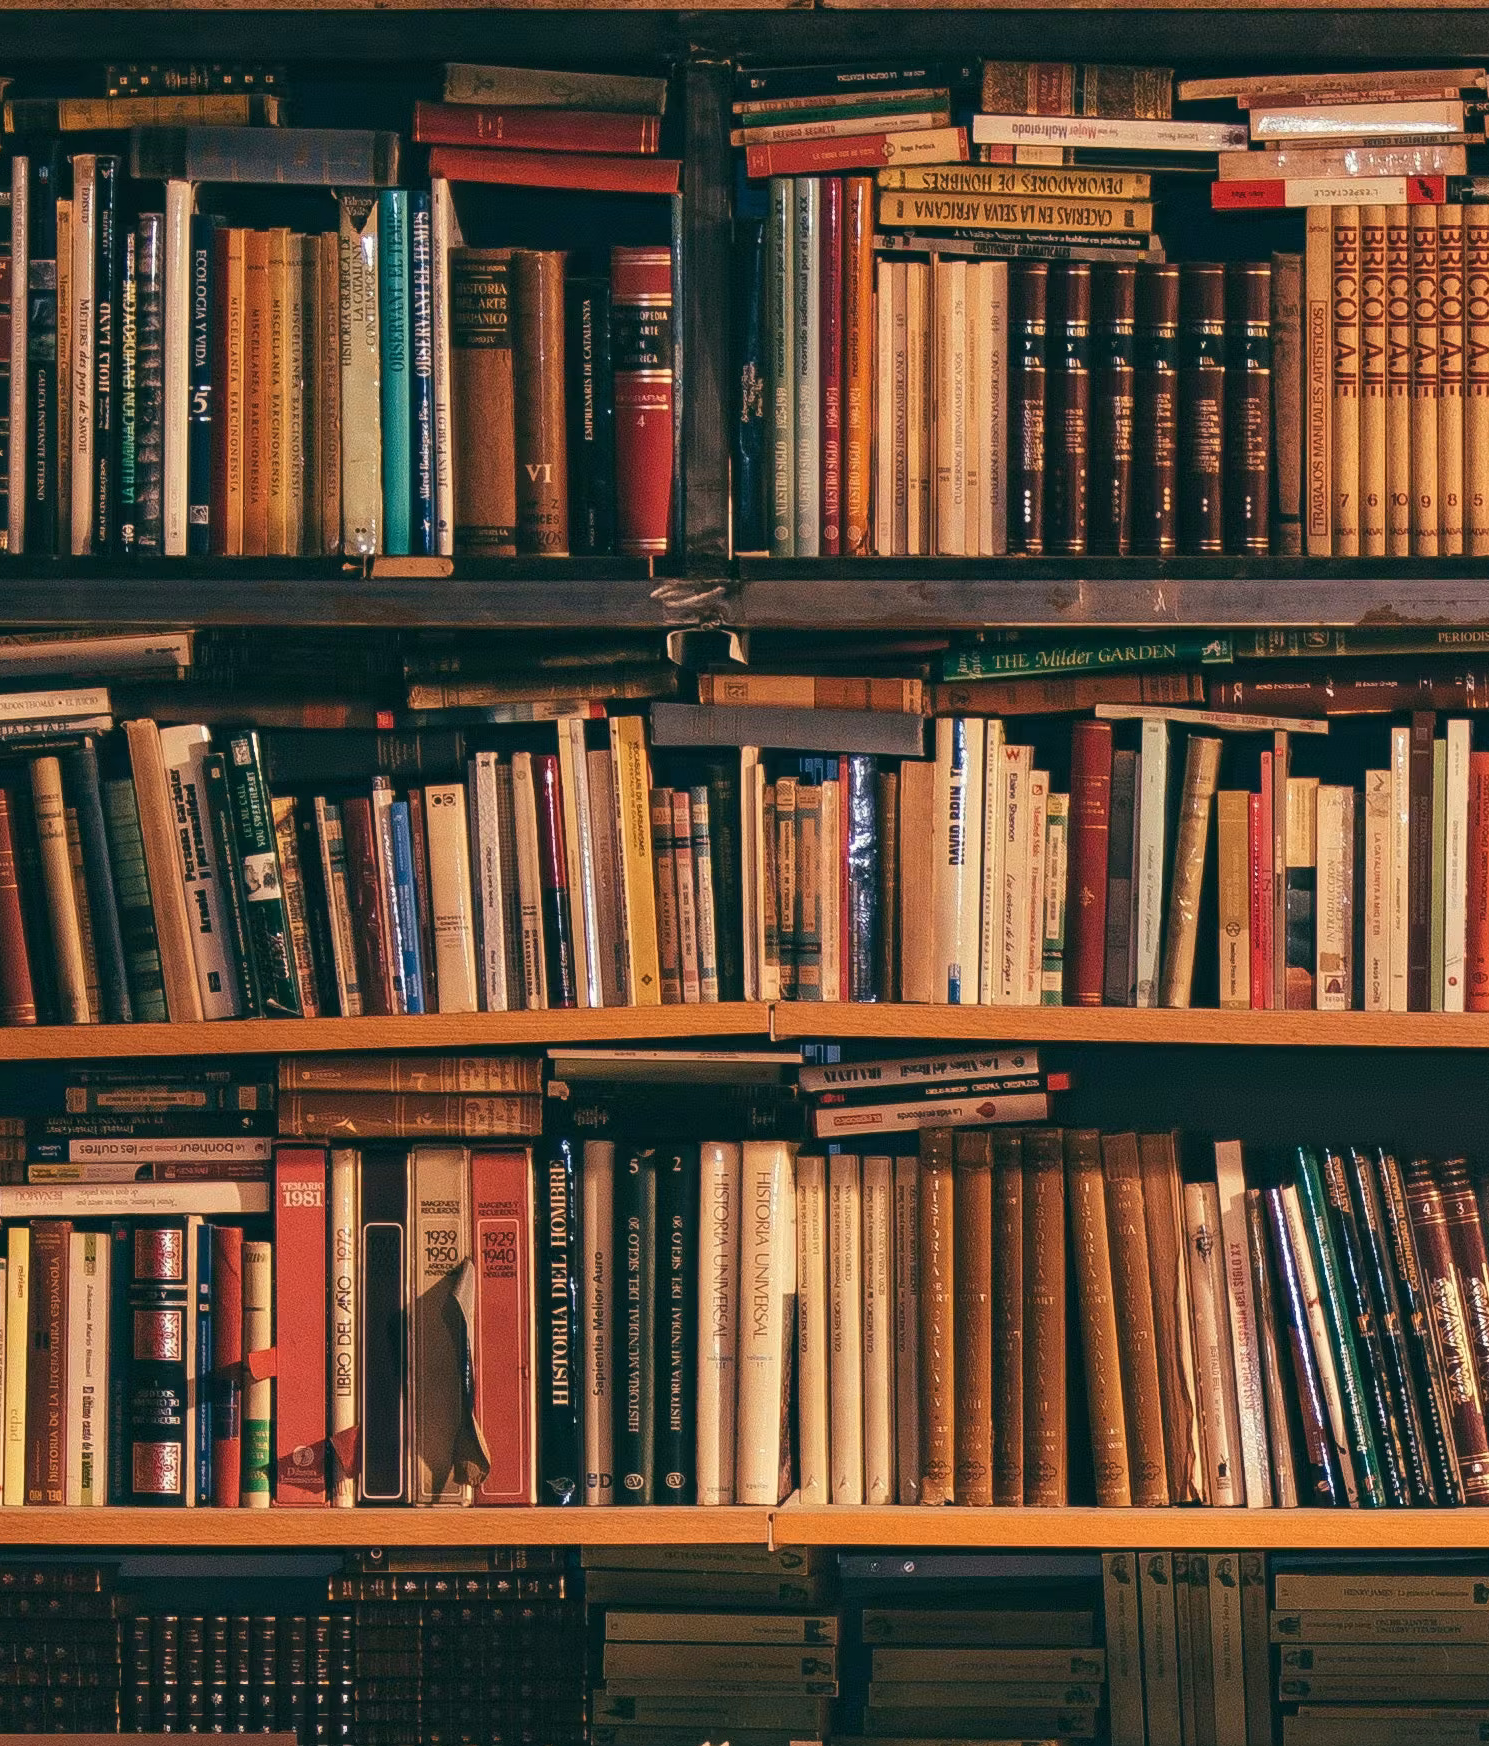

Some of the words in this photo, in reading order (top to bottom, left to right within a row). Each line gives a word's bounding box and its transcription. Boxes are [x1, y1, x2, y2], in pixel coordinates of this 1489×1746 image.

[922, 173, 991, 191] HOMBRES
[998, 174, 1015, 192] DE
[1022, 174, 1123, 195] DEVORADORES
[915, 200, 980, 223] AFRICANA
[983, 203, 1017, 224] SELVA
[1020, 205, 1035, 224] LA
[1038, 206, 1053, 225] EN
[99, 302, 111, 345] LAND
[1334, 225, 1357, 399] BRICOLAJE
[1361, 225, 1383, 399] BRICOLAJE
[99, 352, 111, 393] HOLY
[1313, 387, 1325, 457] MANUALES
[1313, 461, 1325, 527] TRABAJOS
[993, 655, 1029, 669] THE
[1034, 649, 1093, 668] Milder
[1098, 644, 1175, 662] GARDEN
[282, 1191, 323, 1208] 1981
[549, 1158, 567, 1248] HOMBRE
[424, 1230, 457, 1245] 1939
[482, 1231, 515, 1246] 1929
[628, 1217, 640, 1230] 20
[337, 1229, 351, 1263] 1972
[424, 1246, 458, 1262] 1950
[482, 1248, 515, 1263] 1940
[628, 1233, 640, 1272] SIGLO
[550, 1254, 568, 1298] DEL
[592, 1251, 603, 1283] Auro
[333, 1276, 351, 1312] AÑO
[628, 1274, 640, 1301] DEL
[592, 1288, 603, 1331] Melior
[336, 1318, 351, 1346] DEL
[628, 1304, 640, 1368] MUNDIAL
[552, 1304, 569, 1405] HISTORIA
[592, 1335, 605, 1396] Sapientia
[336, 1352, 351, 1398] LIBRO
[628, 1370, 640, 1433] HISTORIA
